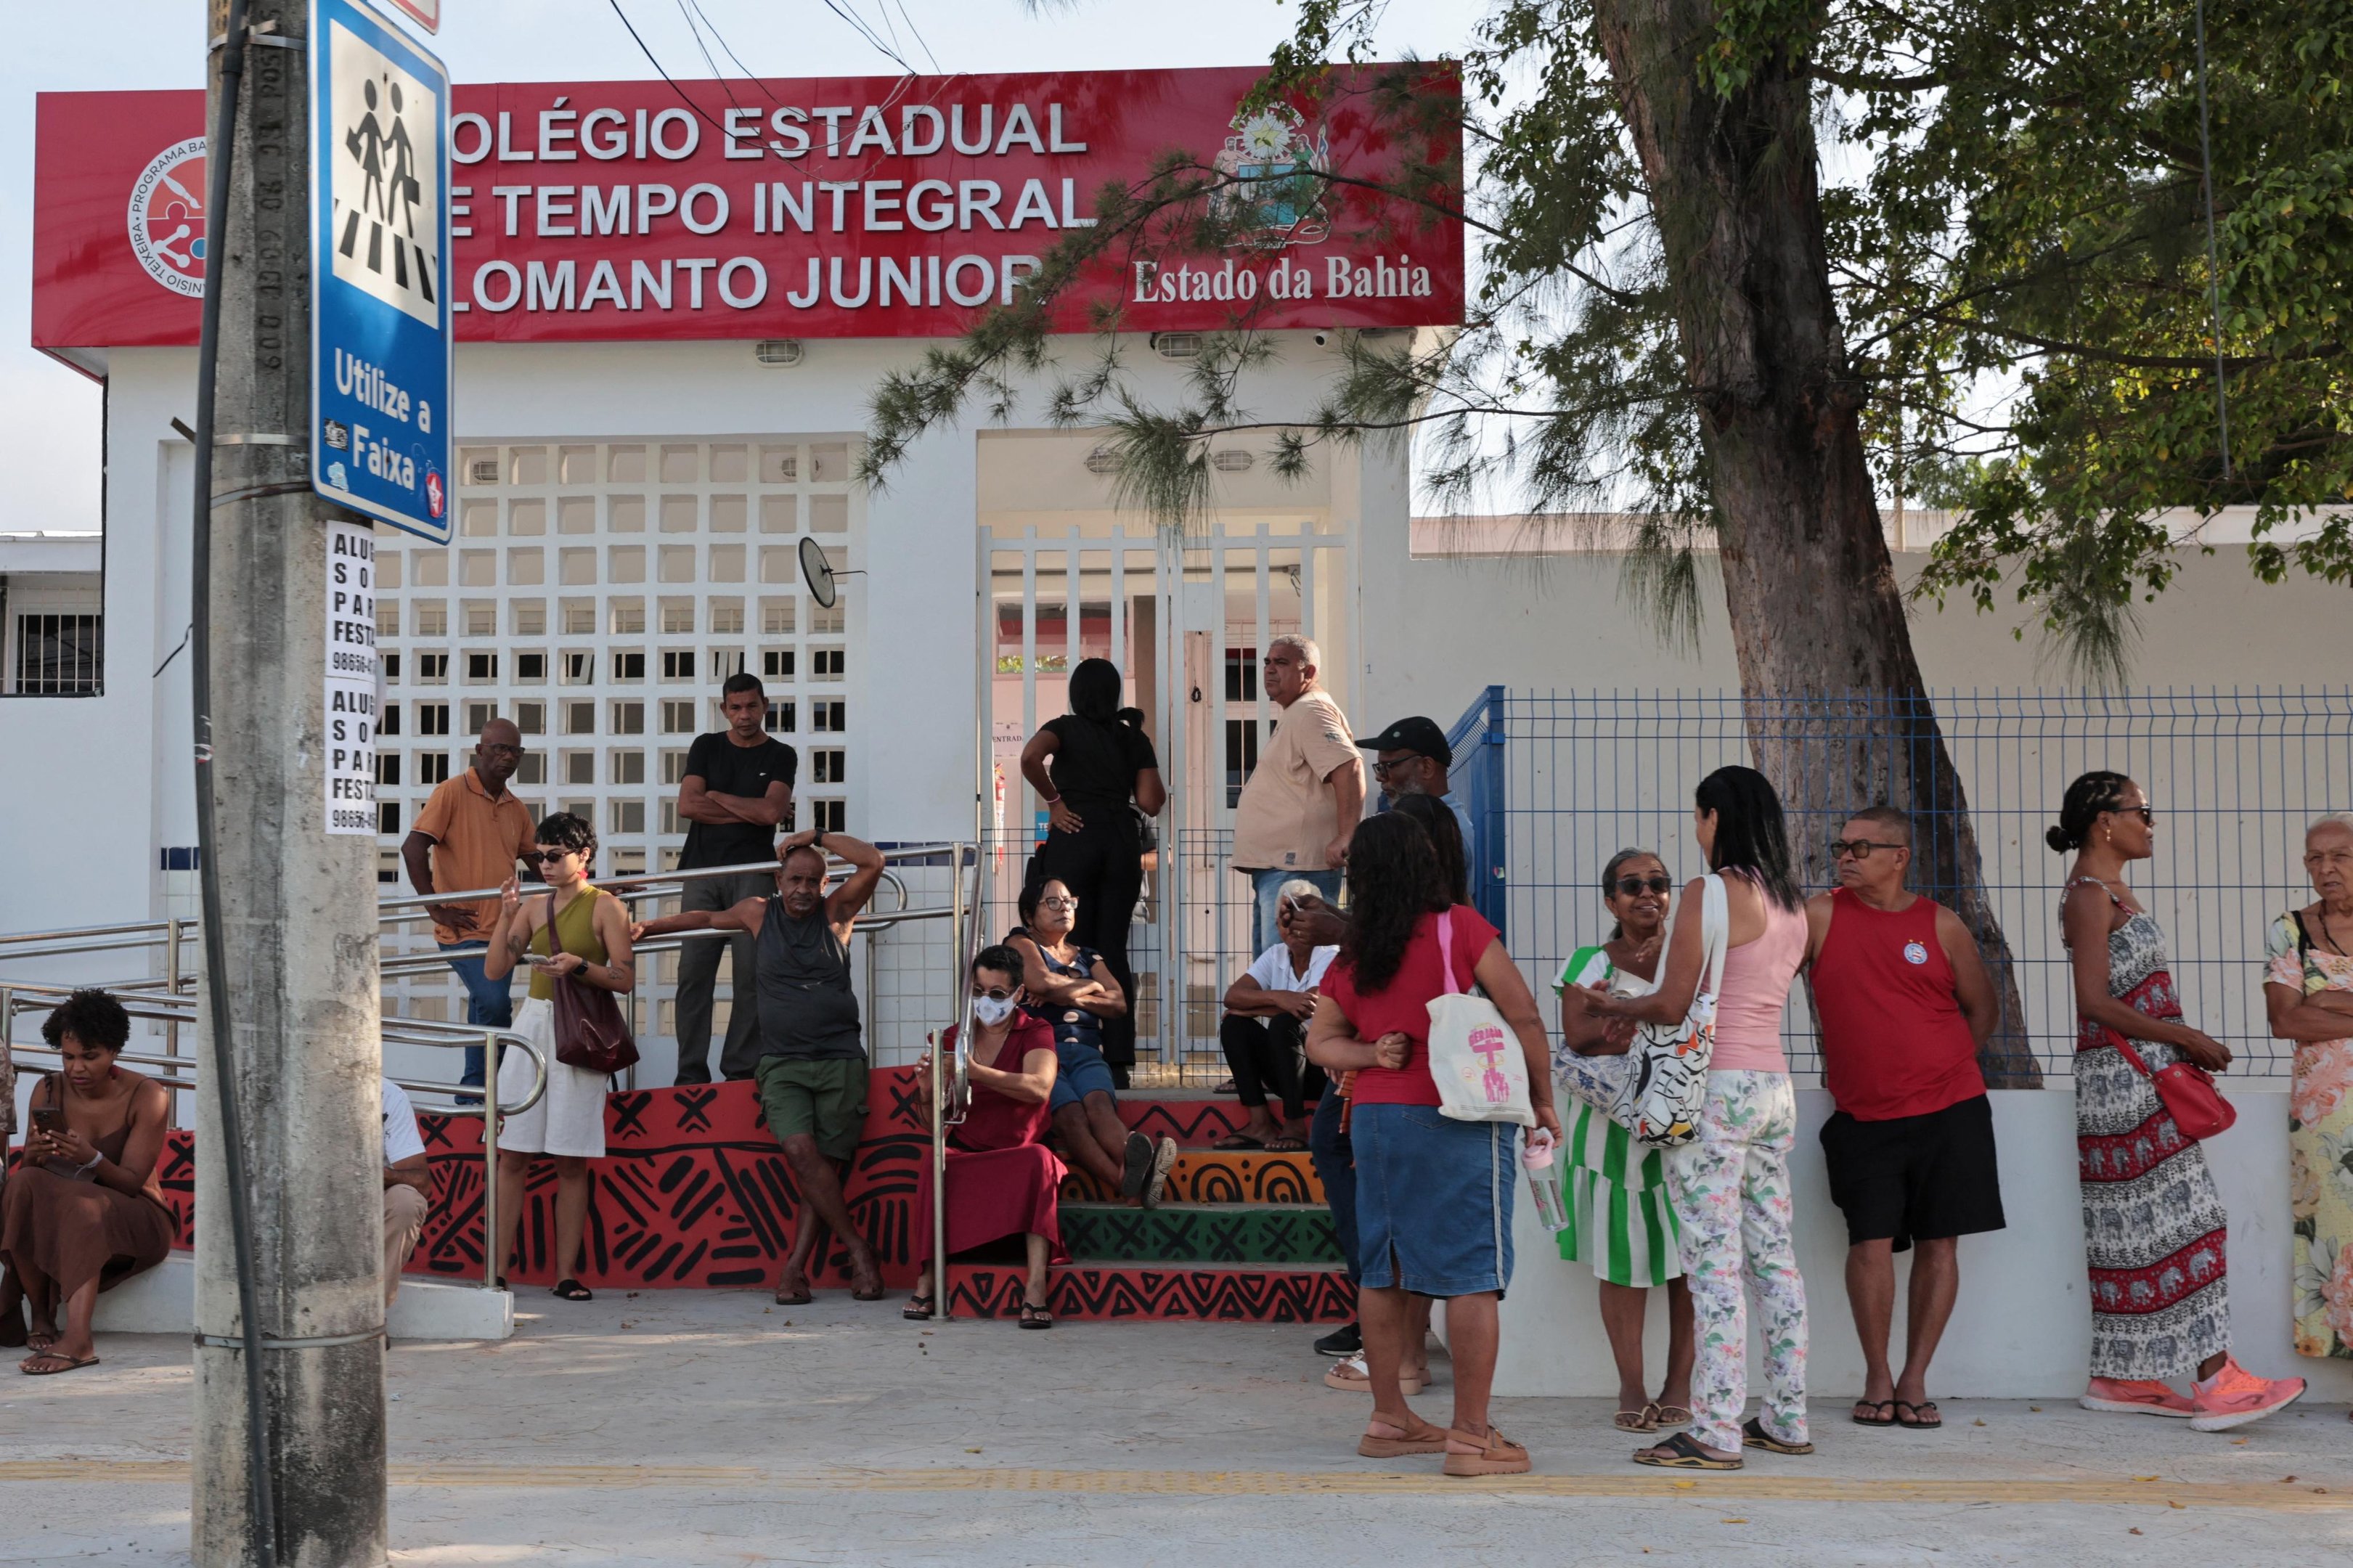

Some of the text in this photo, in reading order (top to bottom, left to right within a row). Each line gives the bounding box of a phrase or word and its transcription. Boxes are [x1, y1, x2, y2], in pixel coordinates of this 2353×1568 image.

[452, 97, 1087, 164] OLÉGIO ESTADUAL
[132, 140, 207, 213] PROGRAMA BA
[452, 178, 1098, 236] E TEMPO INTEGRAL
[132, 221, 206, 295] NÍSIO TEIXEIRA
[452, 254, 1047, 311] OMANTO JUNIOR
[1133, 254, 1432, 303] Estado da Bahia
[335, 347, 431, 434] Utilize a
[353, 423, 415, 491] Faixa
[334, 534, 375, 562] ALUG
[332, 690, 375, 716] ALUG
